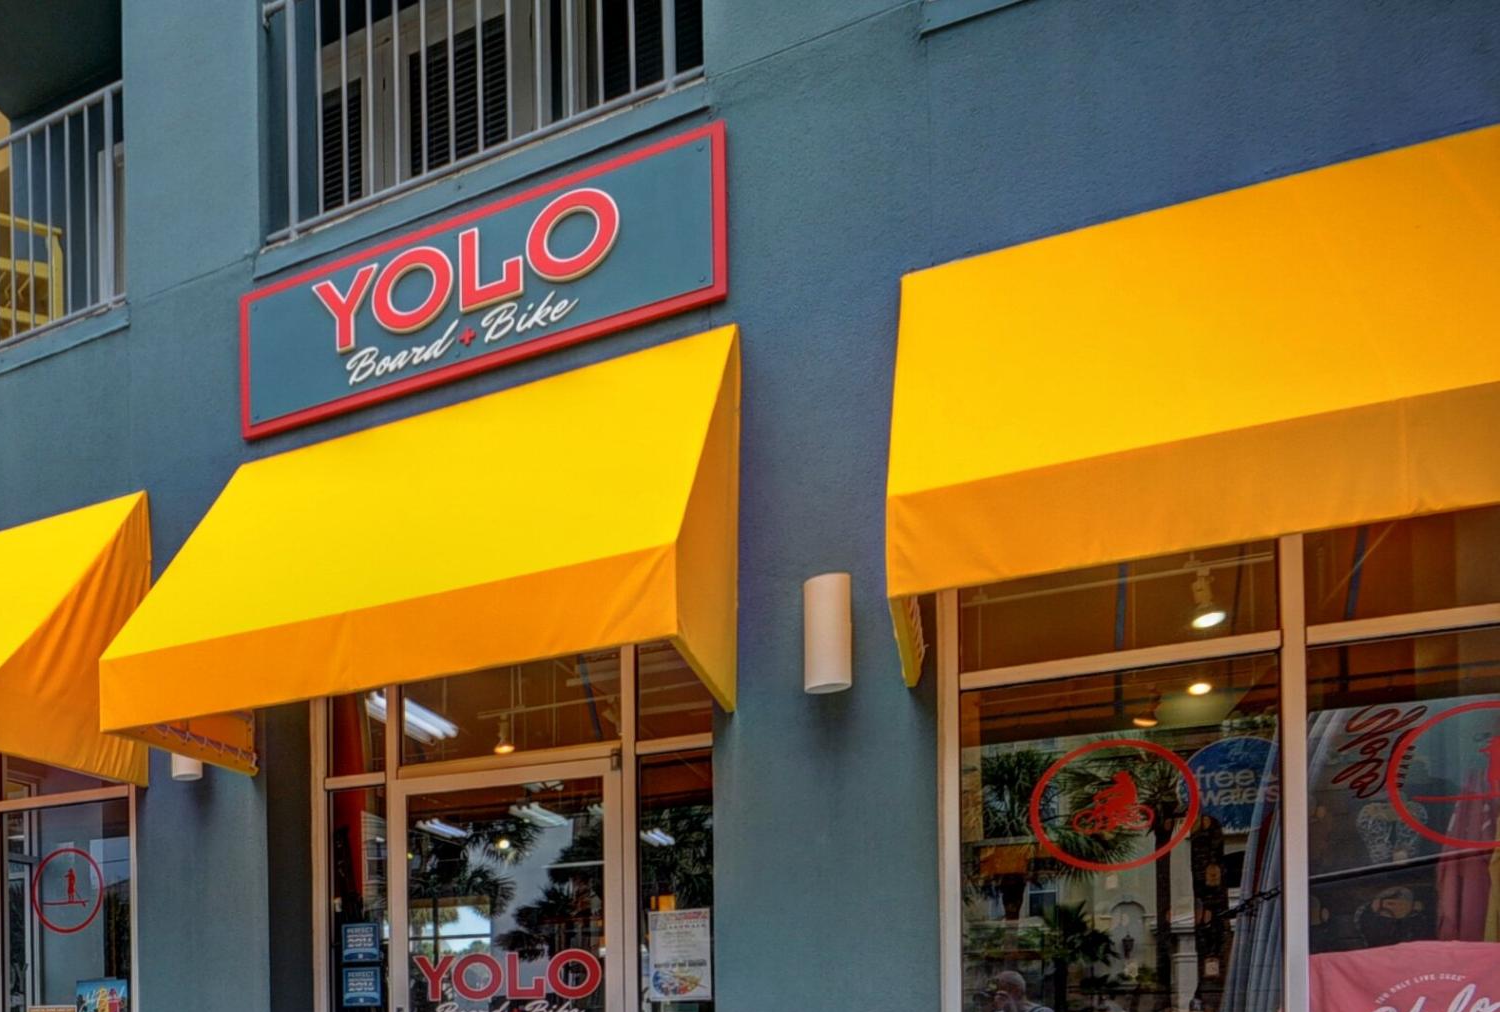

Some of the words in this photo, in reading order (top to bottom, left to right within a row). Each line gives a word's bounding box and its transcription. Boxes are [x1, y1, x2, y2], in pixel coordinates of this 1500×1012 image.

[311, 187, 620, 354] YOLO
[346, 319, 458, 385] Board
[480, 290, 580, 345] Bike
[413, 948, 602, 1001] YOLO
